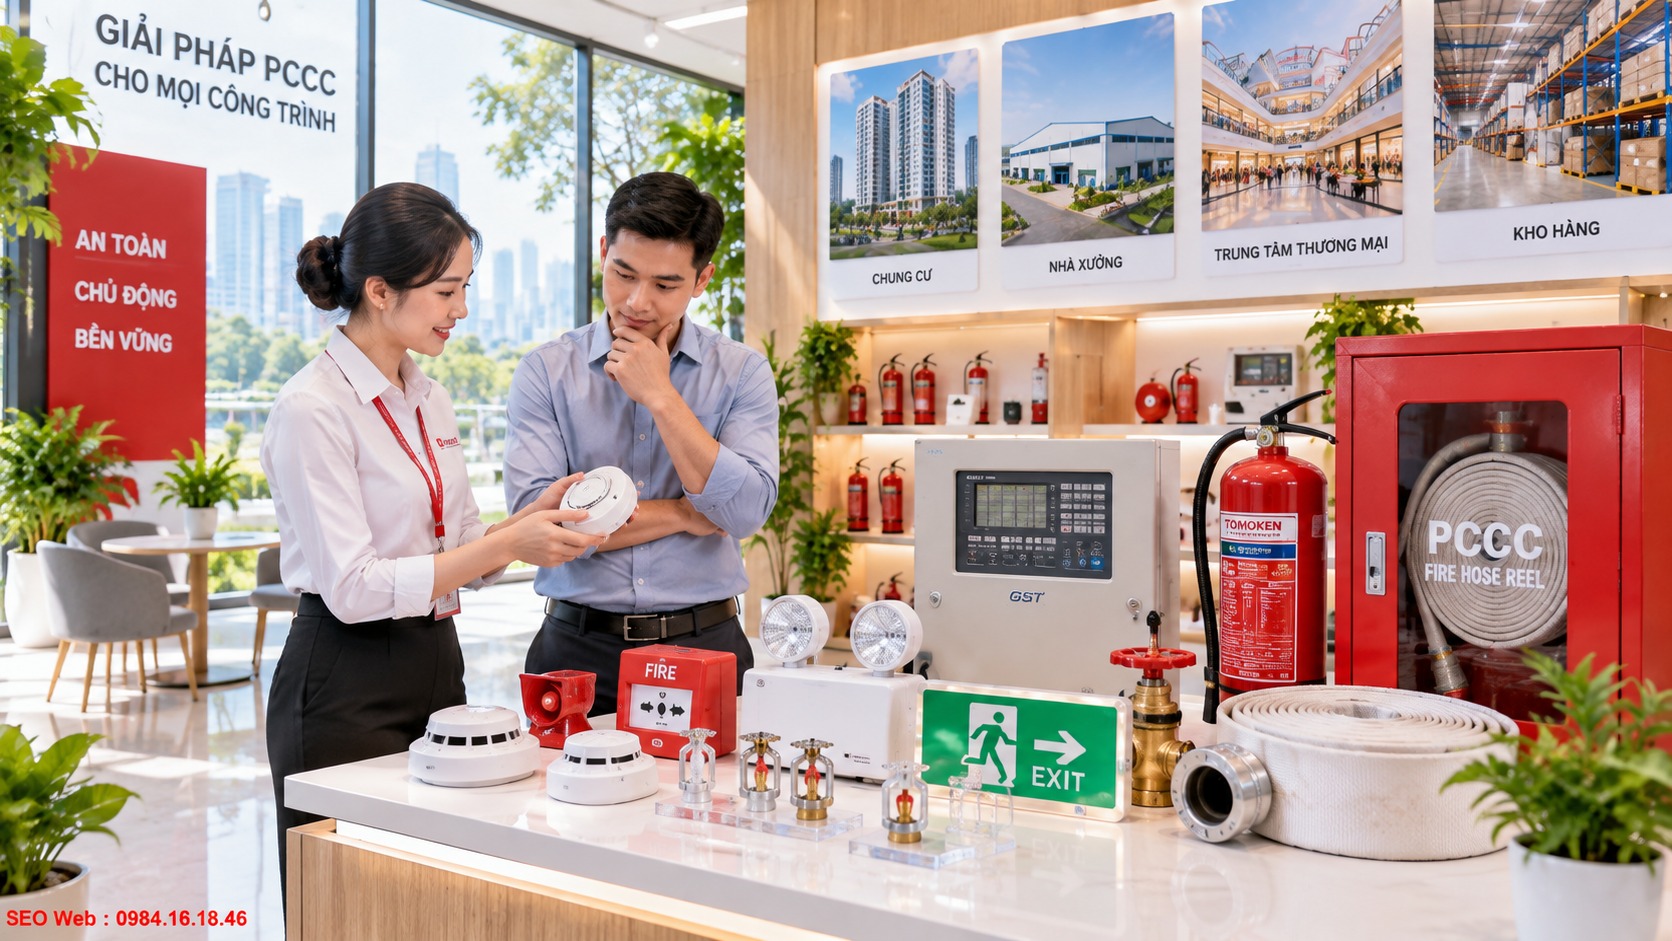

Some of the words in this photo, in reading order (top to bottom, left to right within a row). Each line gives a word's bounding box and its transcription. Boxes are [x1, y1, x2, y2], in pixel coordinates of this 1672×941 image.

[95, 13, 162, 57] GIẢI
[174, 32, 255, 75] PHÁP
[264, 55, 337, 96] PCCC
[94, 60, 149, 94] CHO
[157, 77, 200, 109] MỌI
[208, 84, 271, 120] CÔNG
[277, 98, 336, 133] TRÌNH
[1513, 225, 1548, 241] KHO
[1552, 219, 1600, 238] HÀNG
[75, 229, 106, 253] AN
[111, 232, 167, 259] TOÀN
[1214, 245, 1260, 262] TRUNG
[1263, 241, 1293, 258] TÂM
[1360, 235, 1389, 253] MẠI
[872, 270, 912, 285] CHUNG
[915, 268, 933, 282] CƯ
[1049, 260, 1075, 273] NHÀ
[1078, 253, 1123, 271] XƯỞNG
[74, 278, 118, 304] CHỦ
[122, 282, 177, 311] ĐỘNG
[75, 322, 114, 350] BỀN
[118, 327, 173, 353] VỮNG
[1224, 519, 1282, 531] TOMOKEN
[1428, 519, 1543, 560] PCCC
[1425, 563, 1457, 583] FIRE
[1461, 564, 1501, 586] HOSE
[1505, 568, 1546, 590] REEL
[1010, 591, 1045, 603] GST
[645, 662, 677, 681] FIRE
[1031, 765, 1086, 792] EXIT
